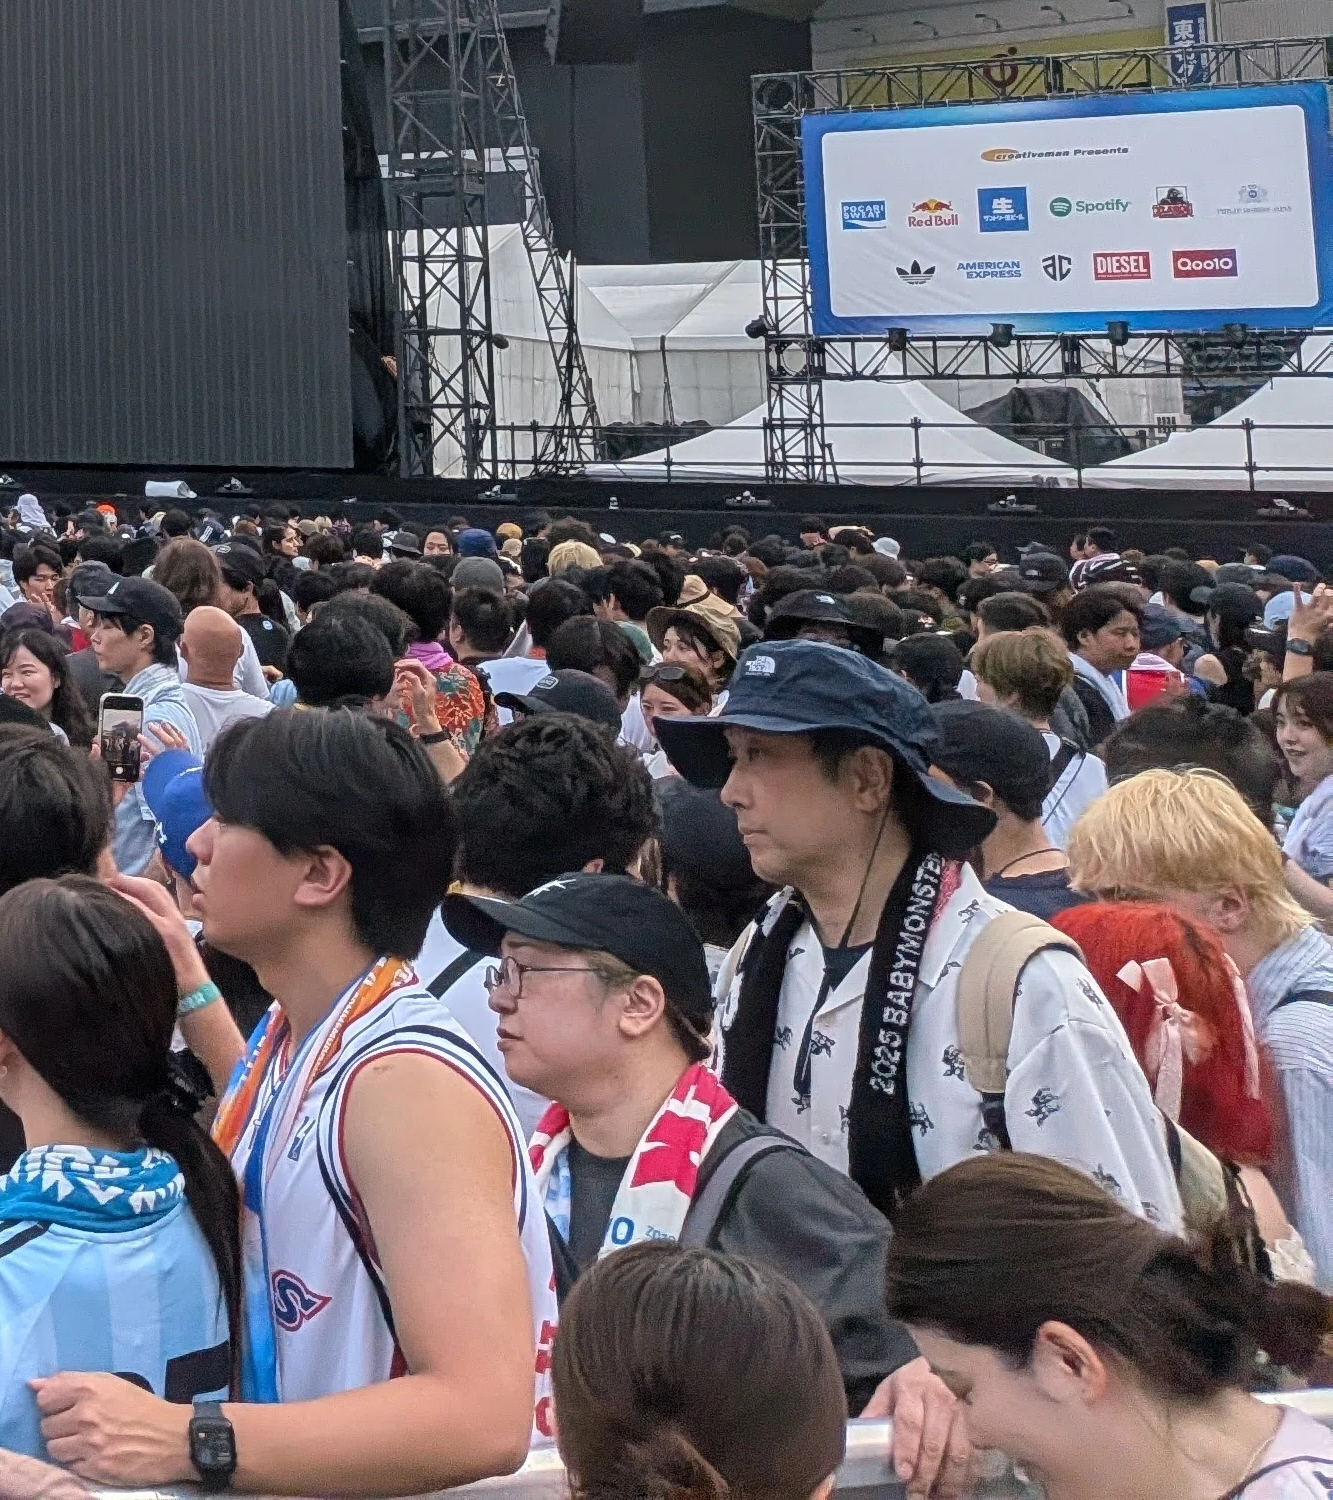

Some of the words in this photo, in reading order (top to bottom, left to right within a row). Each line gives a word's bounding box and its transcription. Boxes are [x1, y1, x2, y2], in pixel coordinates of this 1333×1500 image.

[995, 149, 1071, 161] creativeman
[1073, 146, 1129, 157] Presents
[843, 204, 885, 213] POCARI
[992, 197, 1014, 214] 生
[1075, 198, 1130, 214] Spotify
[843, 212, 881, 220] SWEAT
[908, 216, 933, 227] Red
[934, 214, 959, 226] Bull
[956, 260, 1021, 271] AMERICAN
[1096, 255, 1148, 274] DIESEL
[1177, 257, 1233, 271] Qoo10
[966, 269, 1022, 279] EXPRESS
